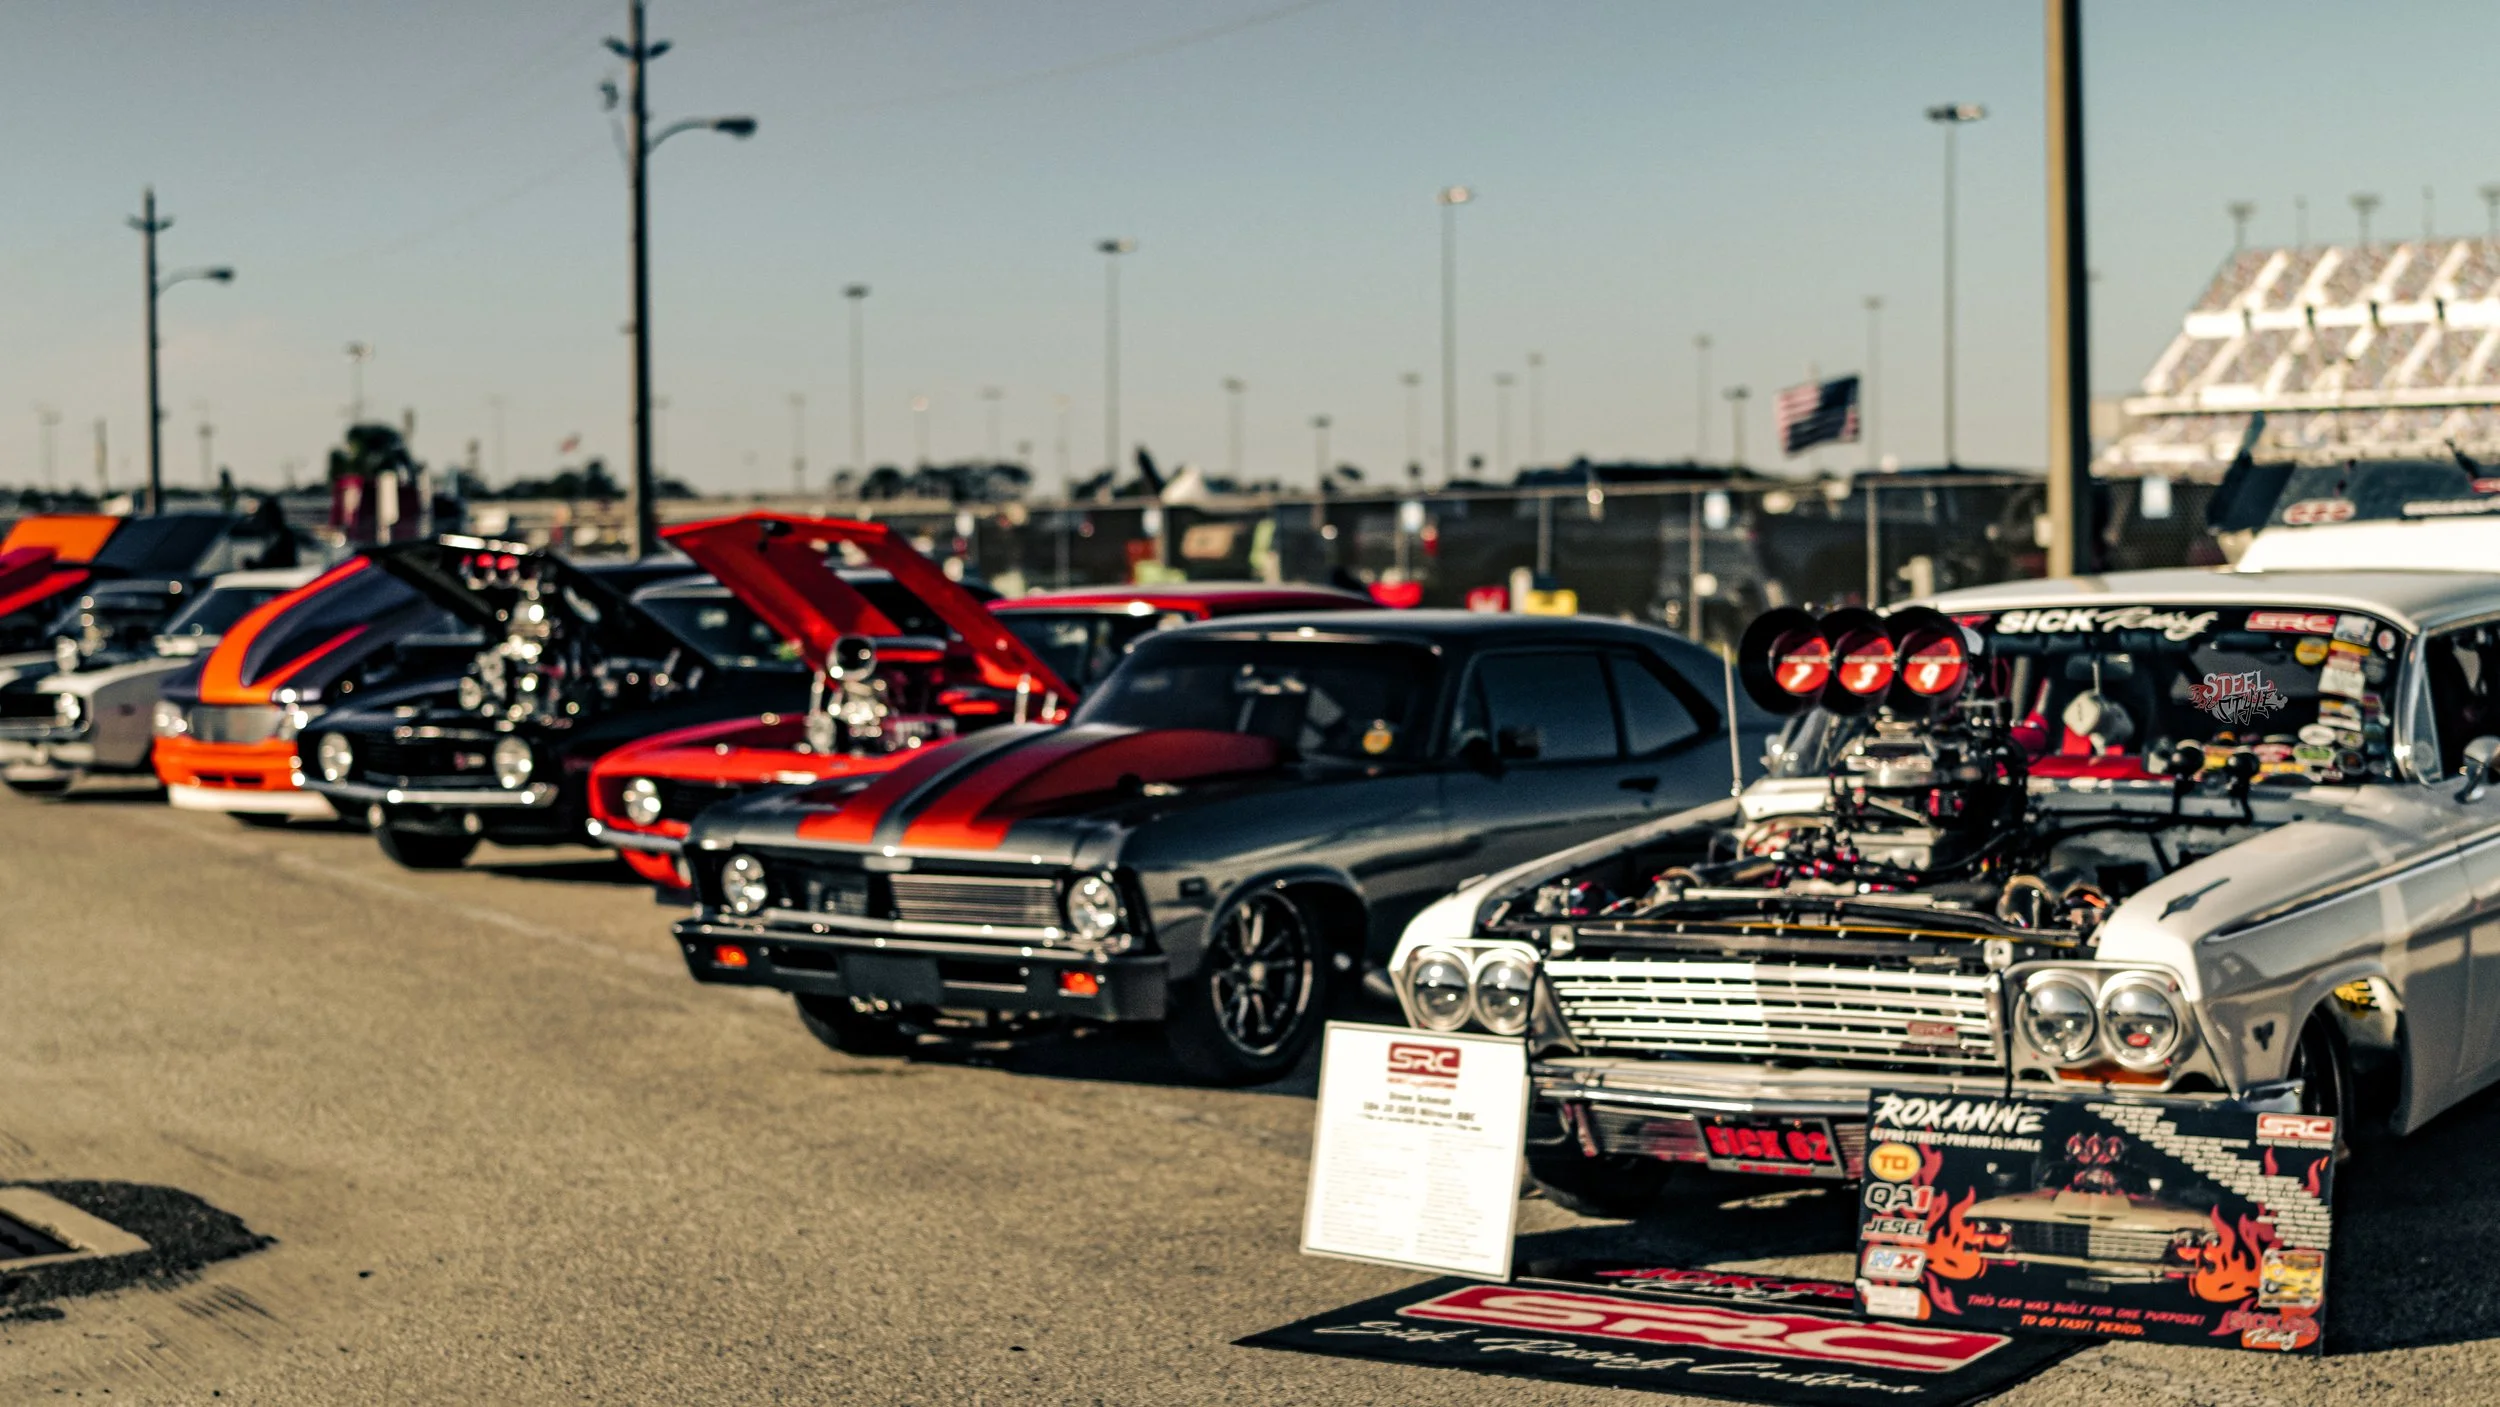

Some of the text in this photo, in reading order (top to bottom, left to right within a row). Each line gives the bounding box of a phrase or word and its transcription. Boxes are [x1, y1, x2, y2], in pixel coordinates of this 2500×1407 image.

[1996, 609, 2099, 634] SICK
[1388, 1047, 1460, 1074] SRC
[1874, 1093, 2049, 1134] ROXANNE
[2259, 1119, 2333, 1140] SRC
[1705, 1126, 1833, 1162] SICK 62
[1865, 1183, 1934, 1214] QA1
[1866, 1219, 1927, 1236] JESEL
[1870, 1251, 1919, 1270] NX
[1998, 1298, 2022, 1309] CAR
[2024, 1301, 2050, 1312] WAS
[2089, 1305, 2114, 1317] FOR
[2115, 1308, 2141, 1320] ONE
[2021, 1314, 2037, 1326] TO
[1405, 1295, 1972, 1370] SRC
